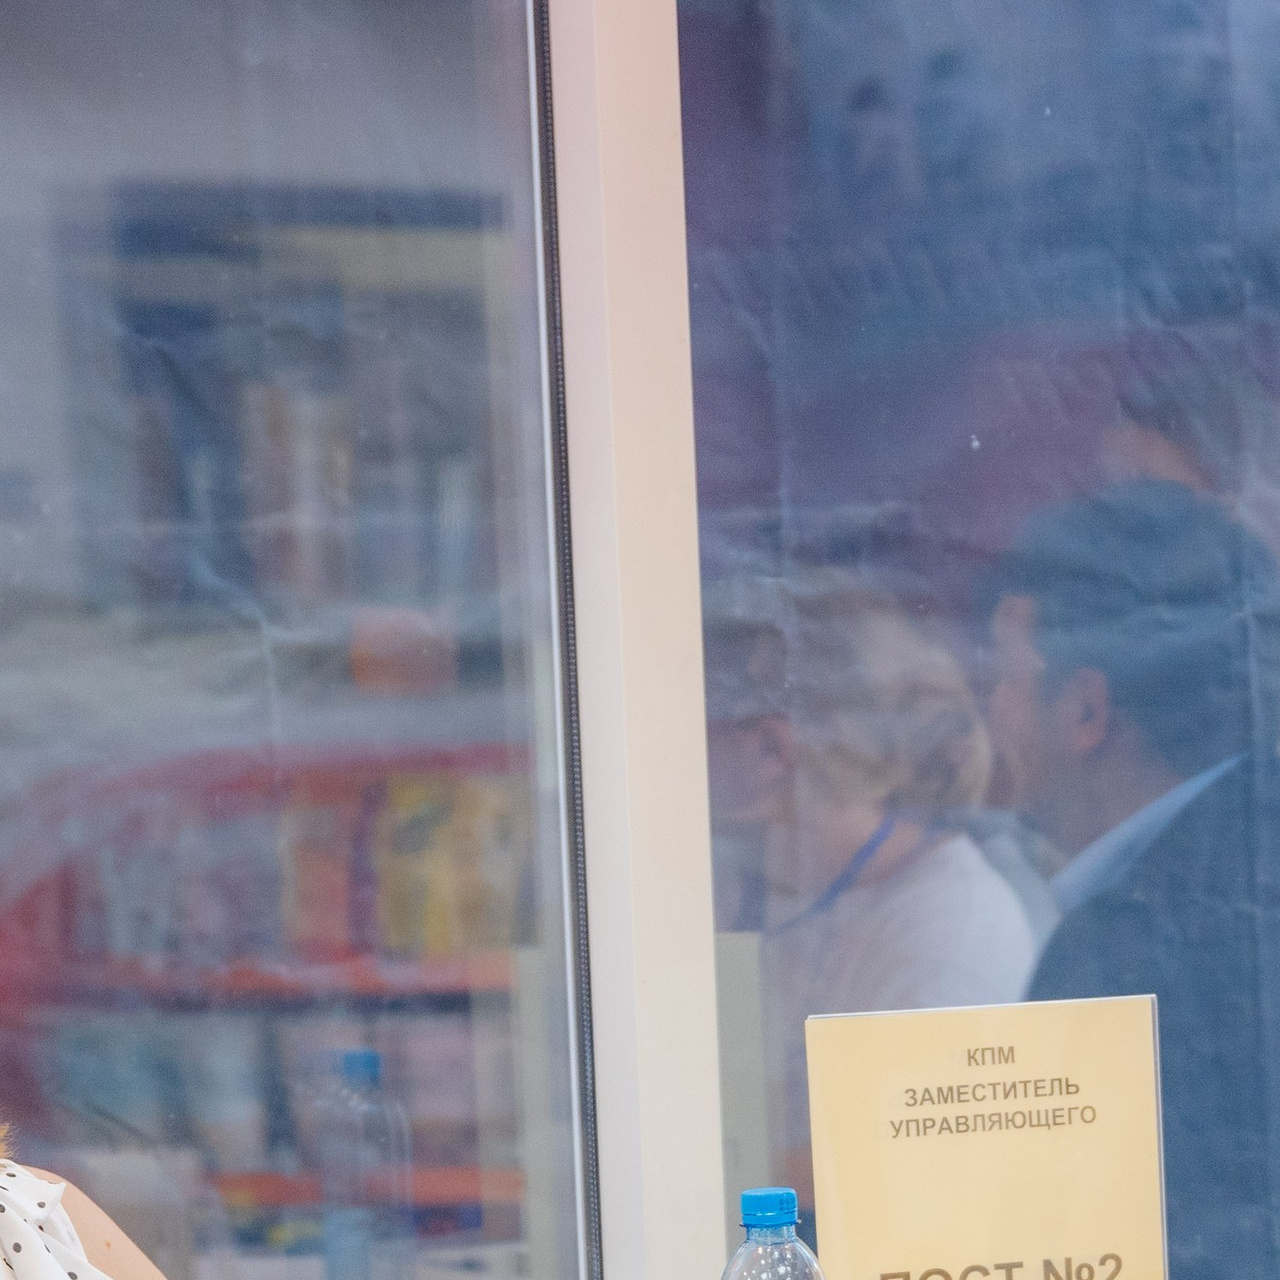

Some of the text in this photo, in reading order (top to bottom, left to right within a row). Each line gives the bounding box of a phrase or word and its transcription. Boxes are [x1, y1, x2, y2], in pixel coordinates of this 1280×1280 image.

[966, 1045, 1016, 1067] КПМ
[904, 1077, 1081, 1107] ЗАМЕСТИТЕЛЬ
[889, 1105, 1097, 1139] УПРАВЛЯЮЩЕГО
